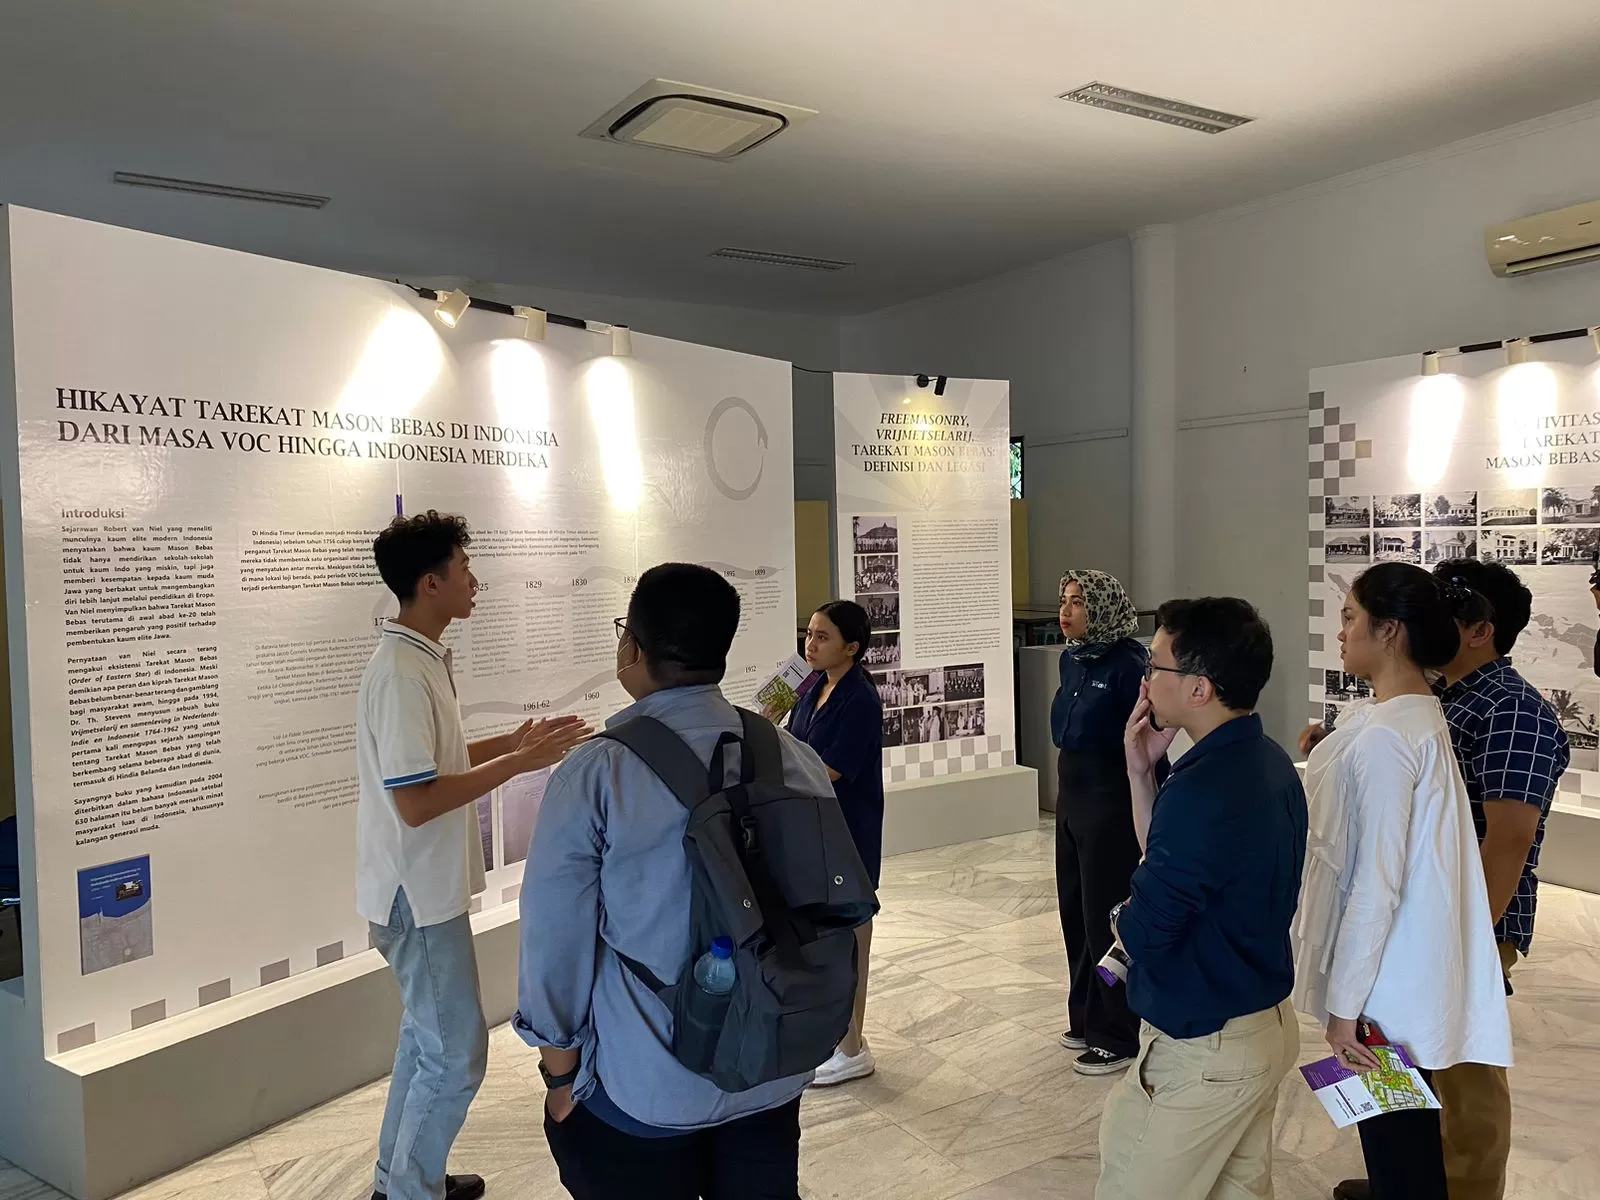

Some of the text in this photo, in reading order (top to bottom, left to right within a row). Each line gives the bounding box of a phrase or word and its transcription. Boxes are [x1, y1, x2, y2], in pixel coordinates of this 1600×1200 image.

[56, 388, 560, 447] HIKAYAT TAREKAT MASON BEBAS DI INDONESIA
[880, 413, 969, 428] FREEMASONRY,
[57, 420, 548, 468] DARI MASA VOC HINGGA INDONESIA MERDEKA
[852, 445, 909, 456] TAREKAT
[914, 446, 955, 456] MASON
[864, 461, 914, 472] DEFINISI
[918, 463, 942, 472] DAN
[1486, 450, 1600, 469] MASON BEBAS
[62, 508, 124, 518] Introduksi
[525, 580, 542, 589] 1829
[572, 578, 588, 587] 1830
[96, 606, 146, 614] menyimpulkan
[113, 625, 145, 634] pengaruh
[66, 638, 115, 647] pembentukan
[67, 656, 107, 664] Pernyataan
[68, 666, 103, 674] mengakui
[523, 692, 600, 712] 1961-62 1960
[74, 794, 112, 805] Sayangnya
[136, 787, 152, 795] yang
[156, 781, 187, 790] kemudian
[74, 804, 113, 815] diterbitkan
[168, 788, 198, 797] Indonesia
[201, 782, 223, 791] setebal
[90, 812, 119, 822] halaman
[155, 801, 177, 811] banyak
[179, 796, 203, 805] menarik
[75, 823, 115, 836] masyarakat
[154, 809, 187, 820] Indonesia,
[192, 801, 224, 812] khususnya
[75, 835, 108, 846] kalangan
[110, 828, 138, 840] generasi
